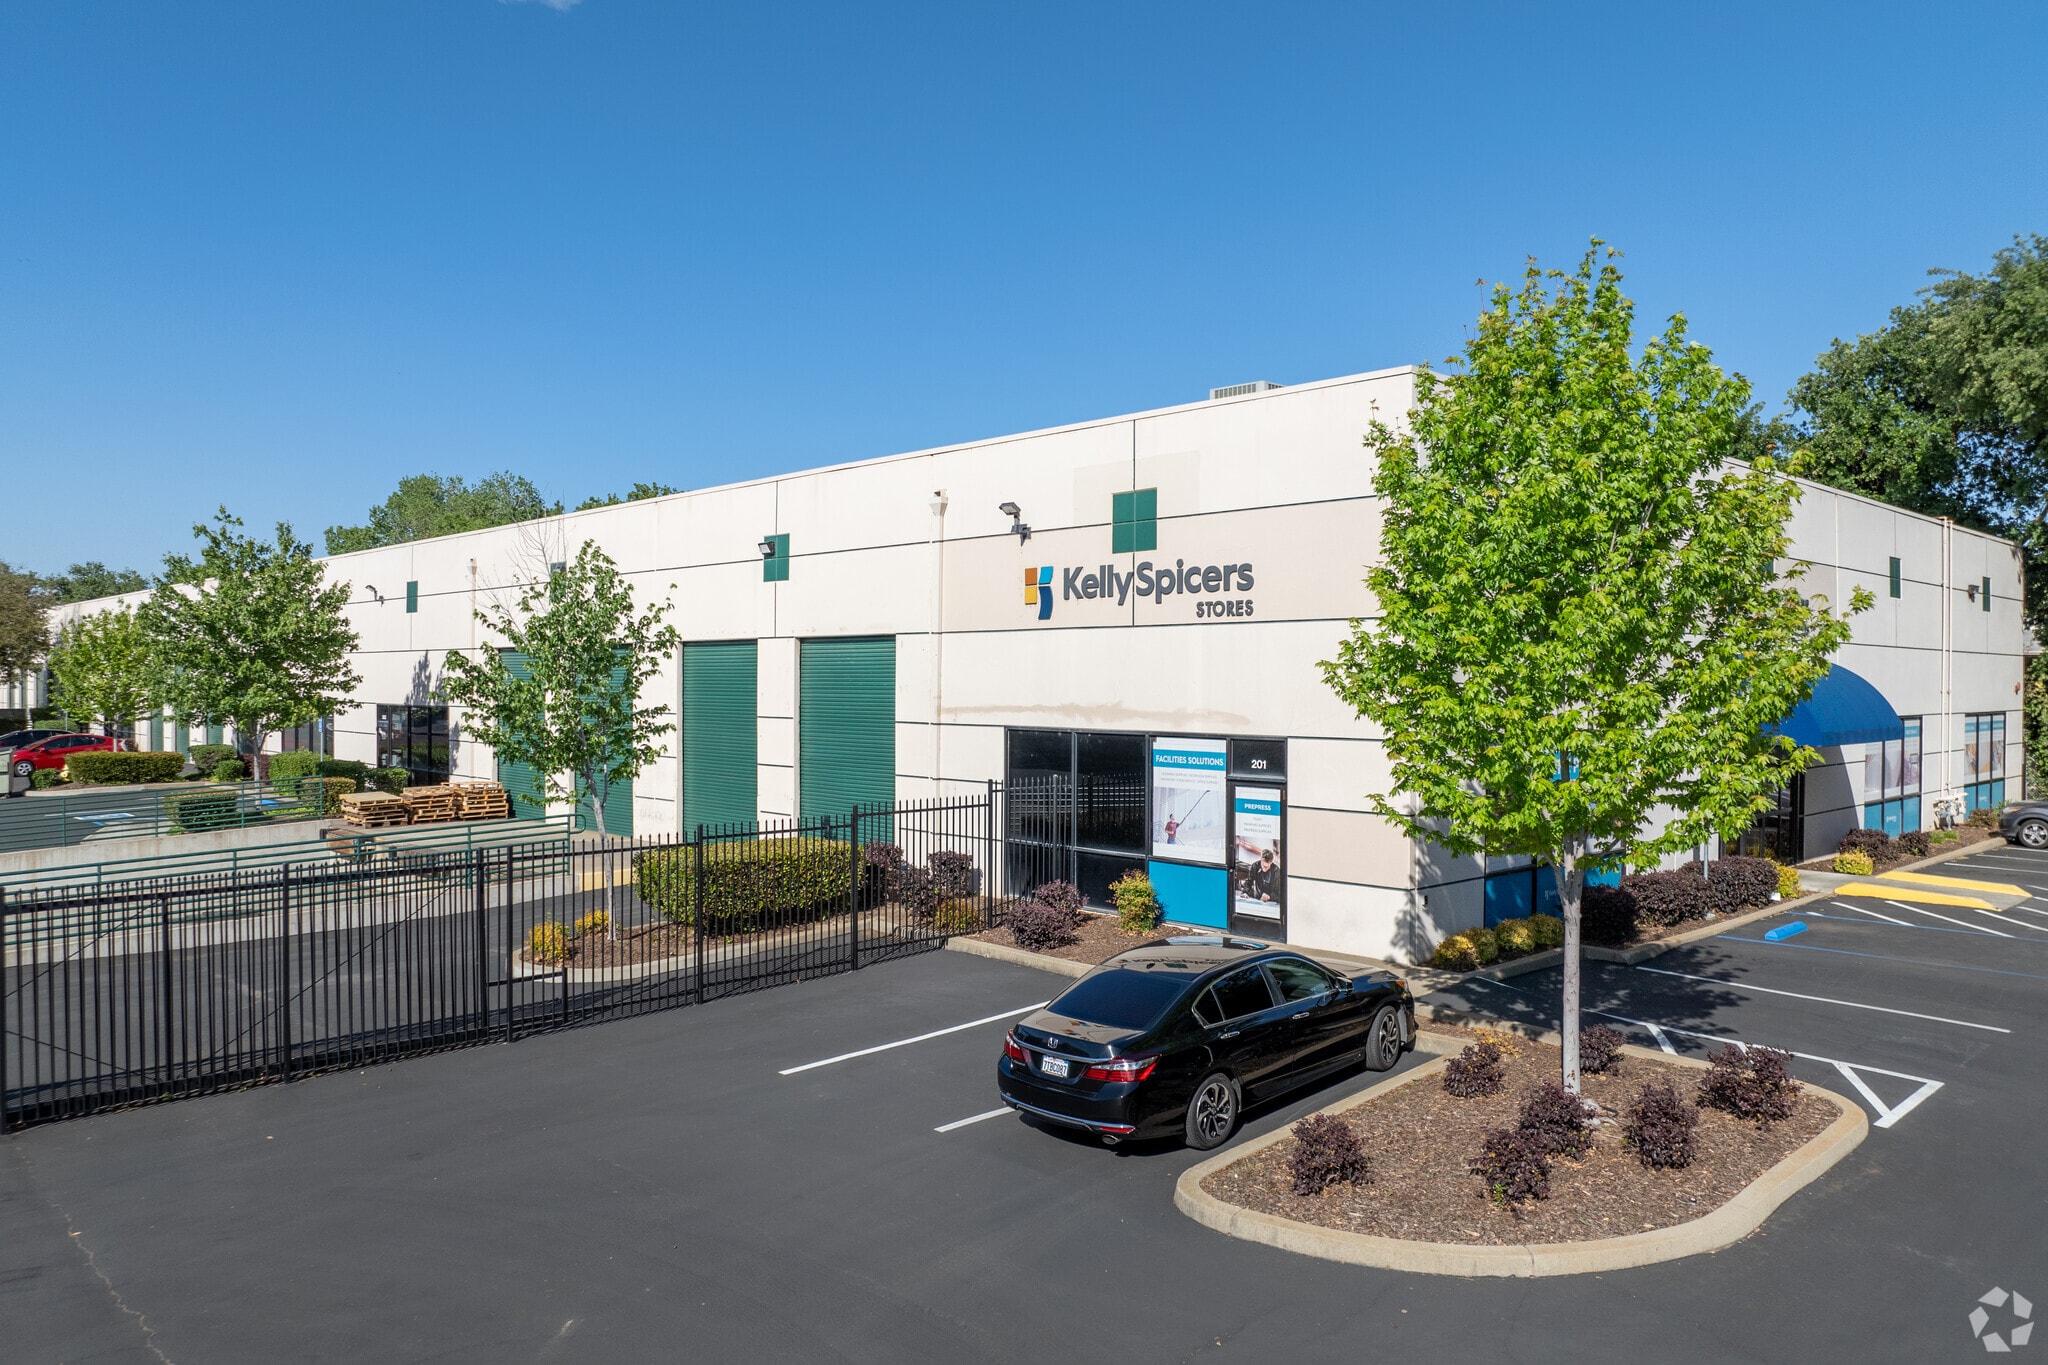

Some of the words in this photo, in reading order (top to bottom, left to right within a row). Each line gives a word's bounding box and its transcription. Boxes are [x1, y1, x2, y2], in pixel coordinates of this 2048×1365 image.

[1063, 559, 1254, 606] KellySpicers
[1196, 600, 1254, 618] STORES
[1156, 755, 1186, 764] FACILITIES
[1188, 756, 1224, 766] SOLUTIONS
[1251, 759, 1267, 769] 201
[1244, 803, 1271, 811] PREPRESS
